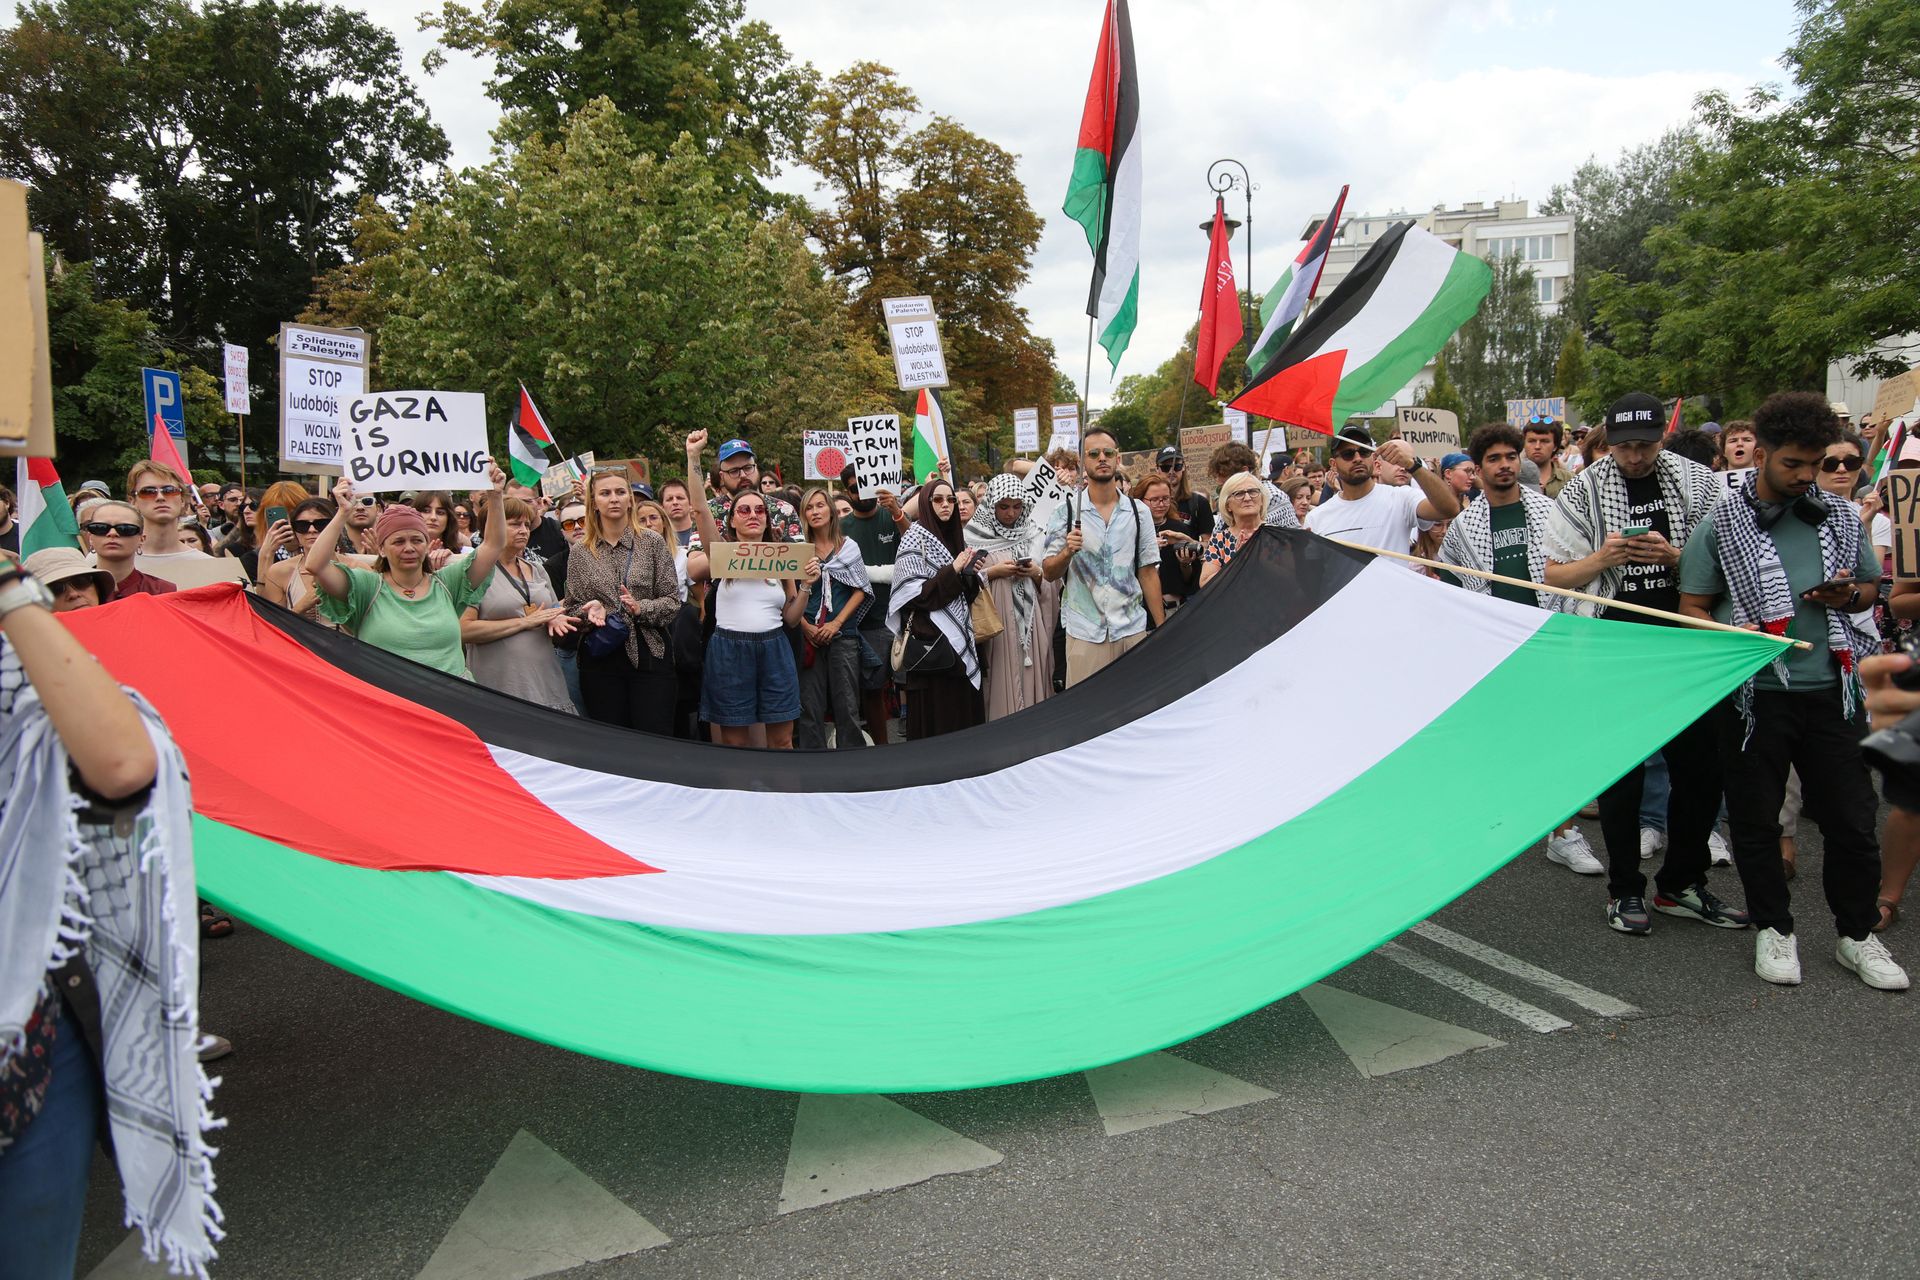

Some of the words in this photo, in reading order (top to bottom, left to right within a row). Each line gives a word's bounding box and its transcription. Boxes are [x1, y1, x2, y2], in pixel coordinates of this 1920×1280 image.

[905, 326, 924, 338] STOP
[296, 334, 356, 350] Solidarnie
[898, 343, 938, 355] ludobójstwu
[302, 343, 359, 360] Palestyną
[910, 360, 934, 370] WOLNA
[309, 368, 342, 388] STOP
[905, 371, 943, 382] PALESTYNA!
[153, 376, 174, 415] P
[290, 392, 338, 417] ludobójs
[350, 396, 447, 423] GAZA
[1403, 410, 1437, 424] FUCK
[1615, 411, 1633, 423] HIGH
[1635, 410, 1652, 421] FIVE
[852, 419, 896, 435] FUCK
[351, 426, 389, 451] is
[804, 439, 850, 447] PALESTYNA
[818, 432, 849, 440] WOLNA
[291, 441, 343, 456] PALESTYN
[852, 437, 898, 453] TRUM
[350, 450, 491, 481] BURNING
[1630, 499, 1665, 514] versit
[1630, 517, 1653, 527] ure
[1493, 528, 1528, 549] ANGEL
[736, 543, 789, 558] STOP
[727, 558, 798, 571] KILLING
